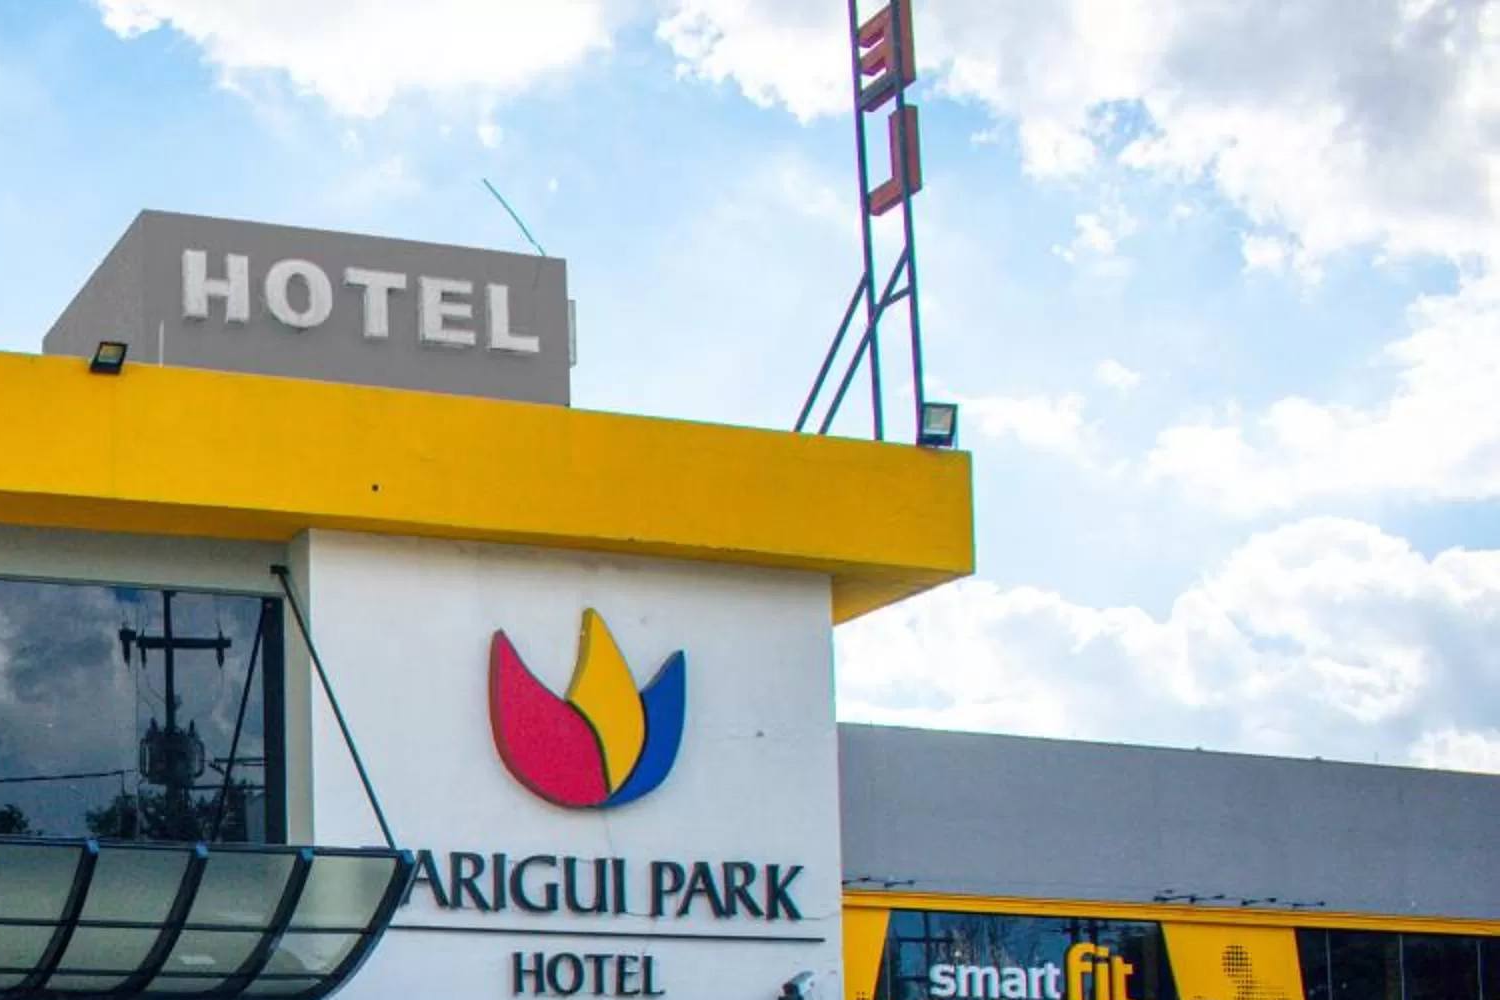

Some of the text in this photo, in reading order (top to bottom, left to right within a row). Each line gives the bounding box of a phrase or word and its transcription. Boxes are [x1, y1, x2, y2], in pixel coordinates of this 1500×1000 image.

[181, 249, 540, 354] HOTEL
[401, 849, 804, 920] ARIGUI PARK
[513, 951, 666, 996] HOTEL
[929, 956, 1061, 1000] smart
